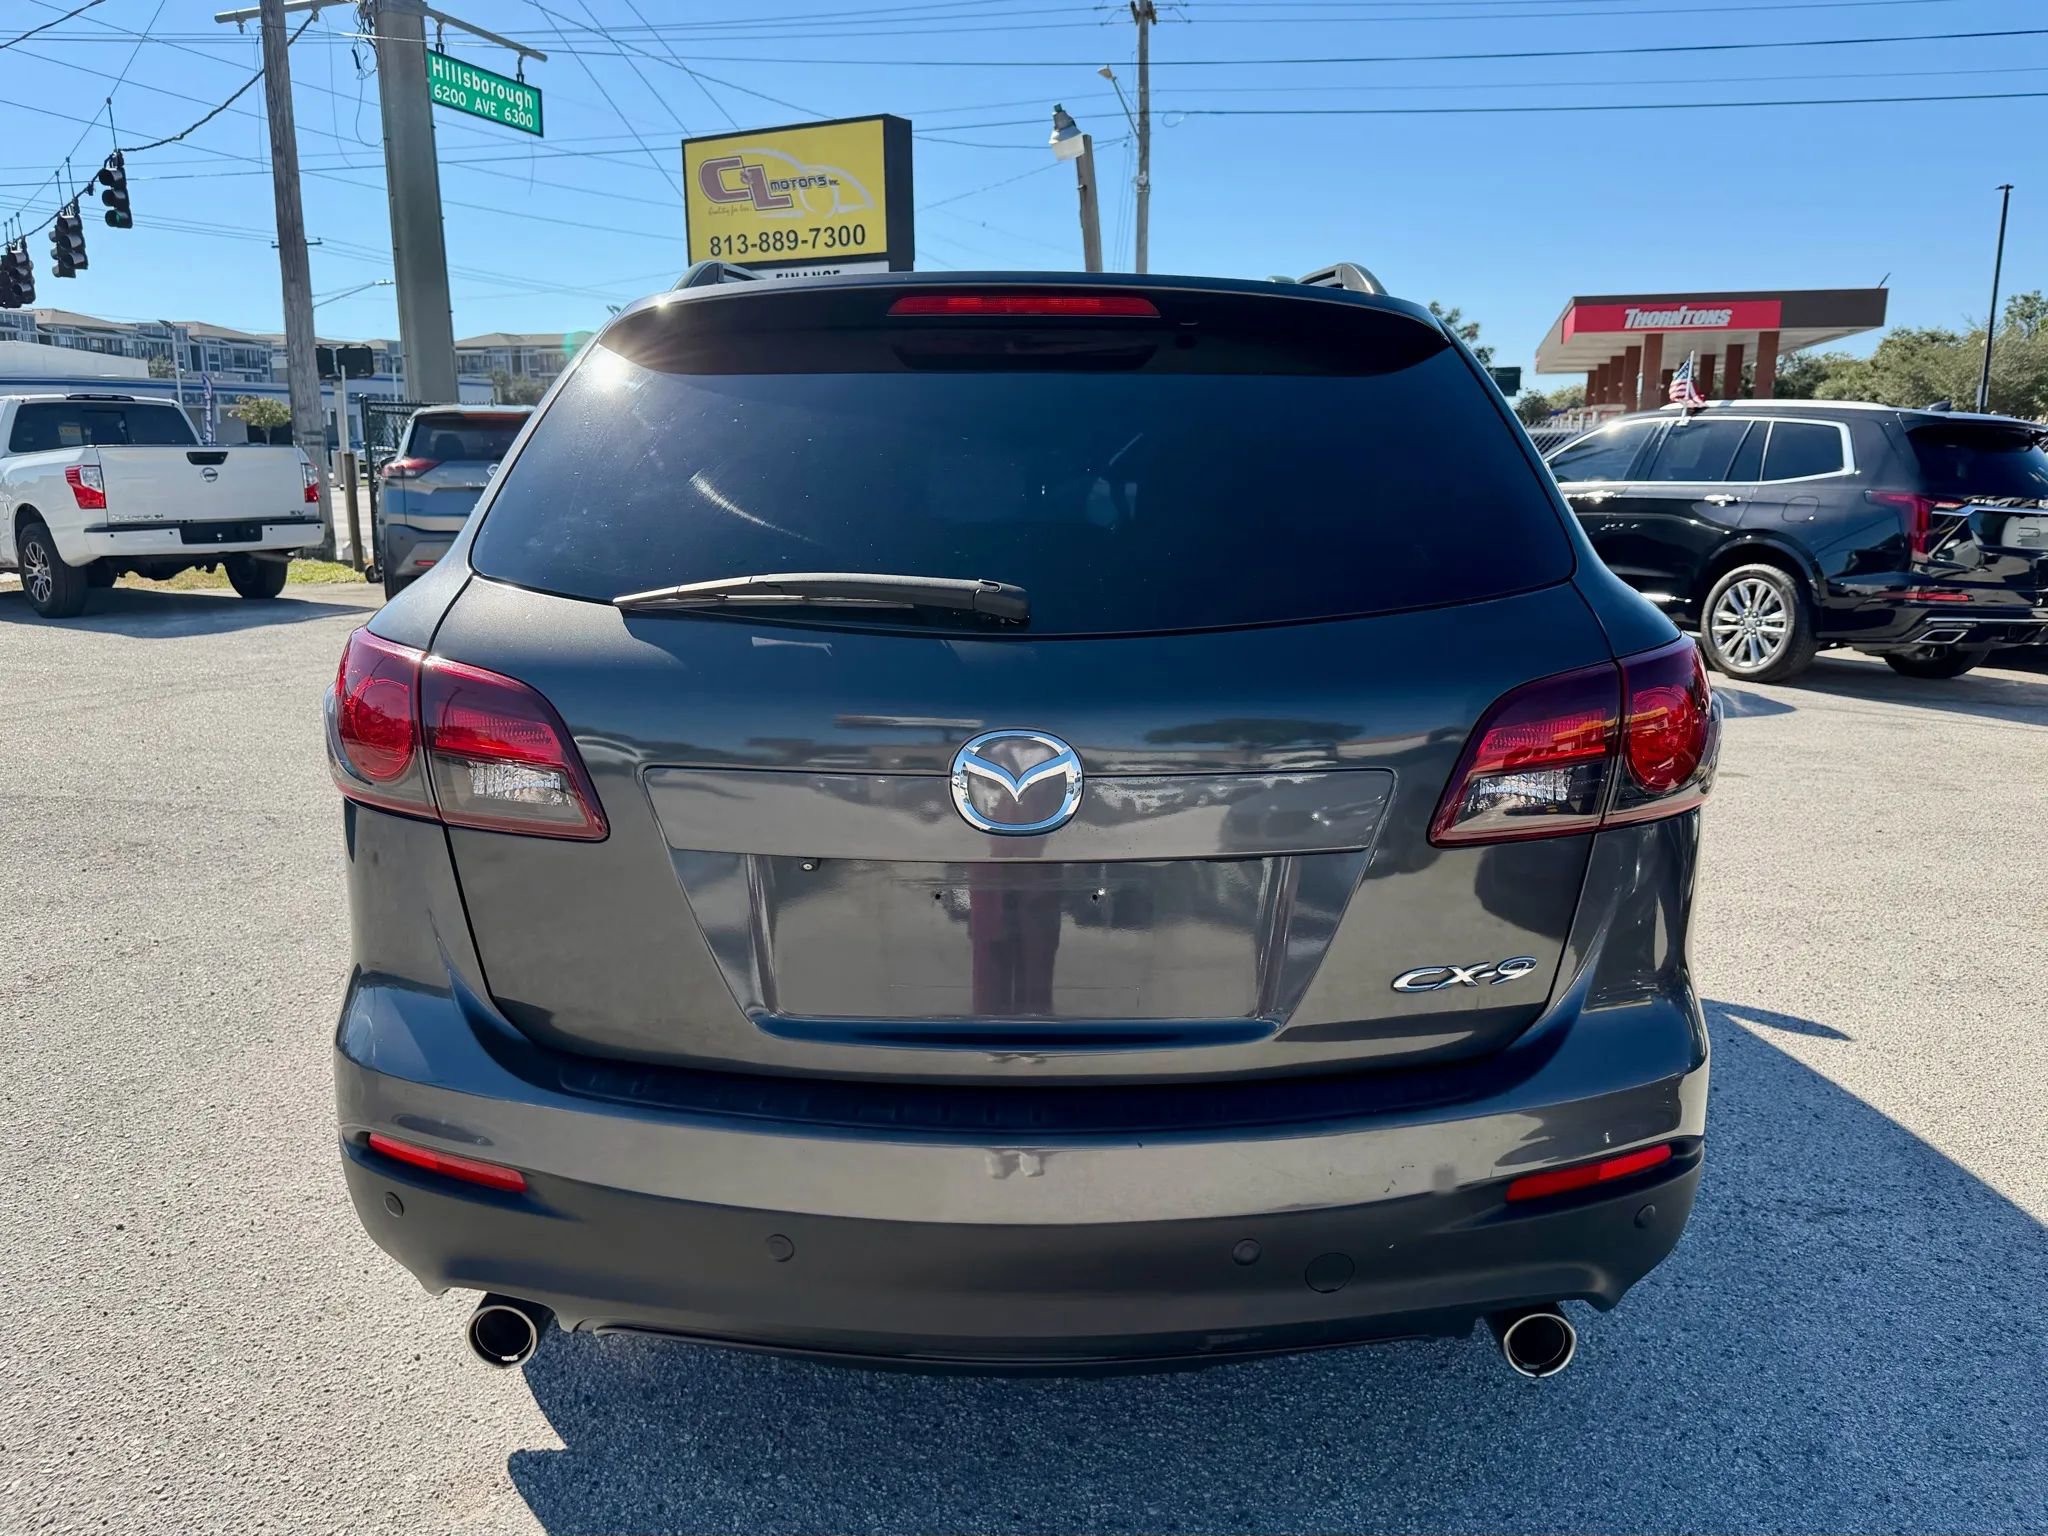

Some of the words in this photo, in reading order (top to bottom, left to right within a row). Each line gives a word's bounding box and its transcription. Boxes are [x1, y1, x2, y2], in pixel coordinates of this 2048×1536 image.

[432, 56, 533, 110] Hillsborough
[434, 84, 467, 107] 6200
[474, 97, 498, 117] AVE
[504, 107, 533, 128] 6300
[710, 224, 866, 257] 813-889-7300
[1391, 956, 1537, 993] CX-9
